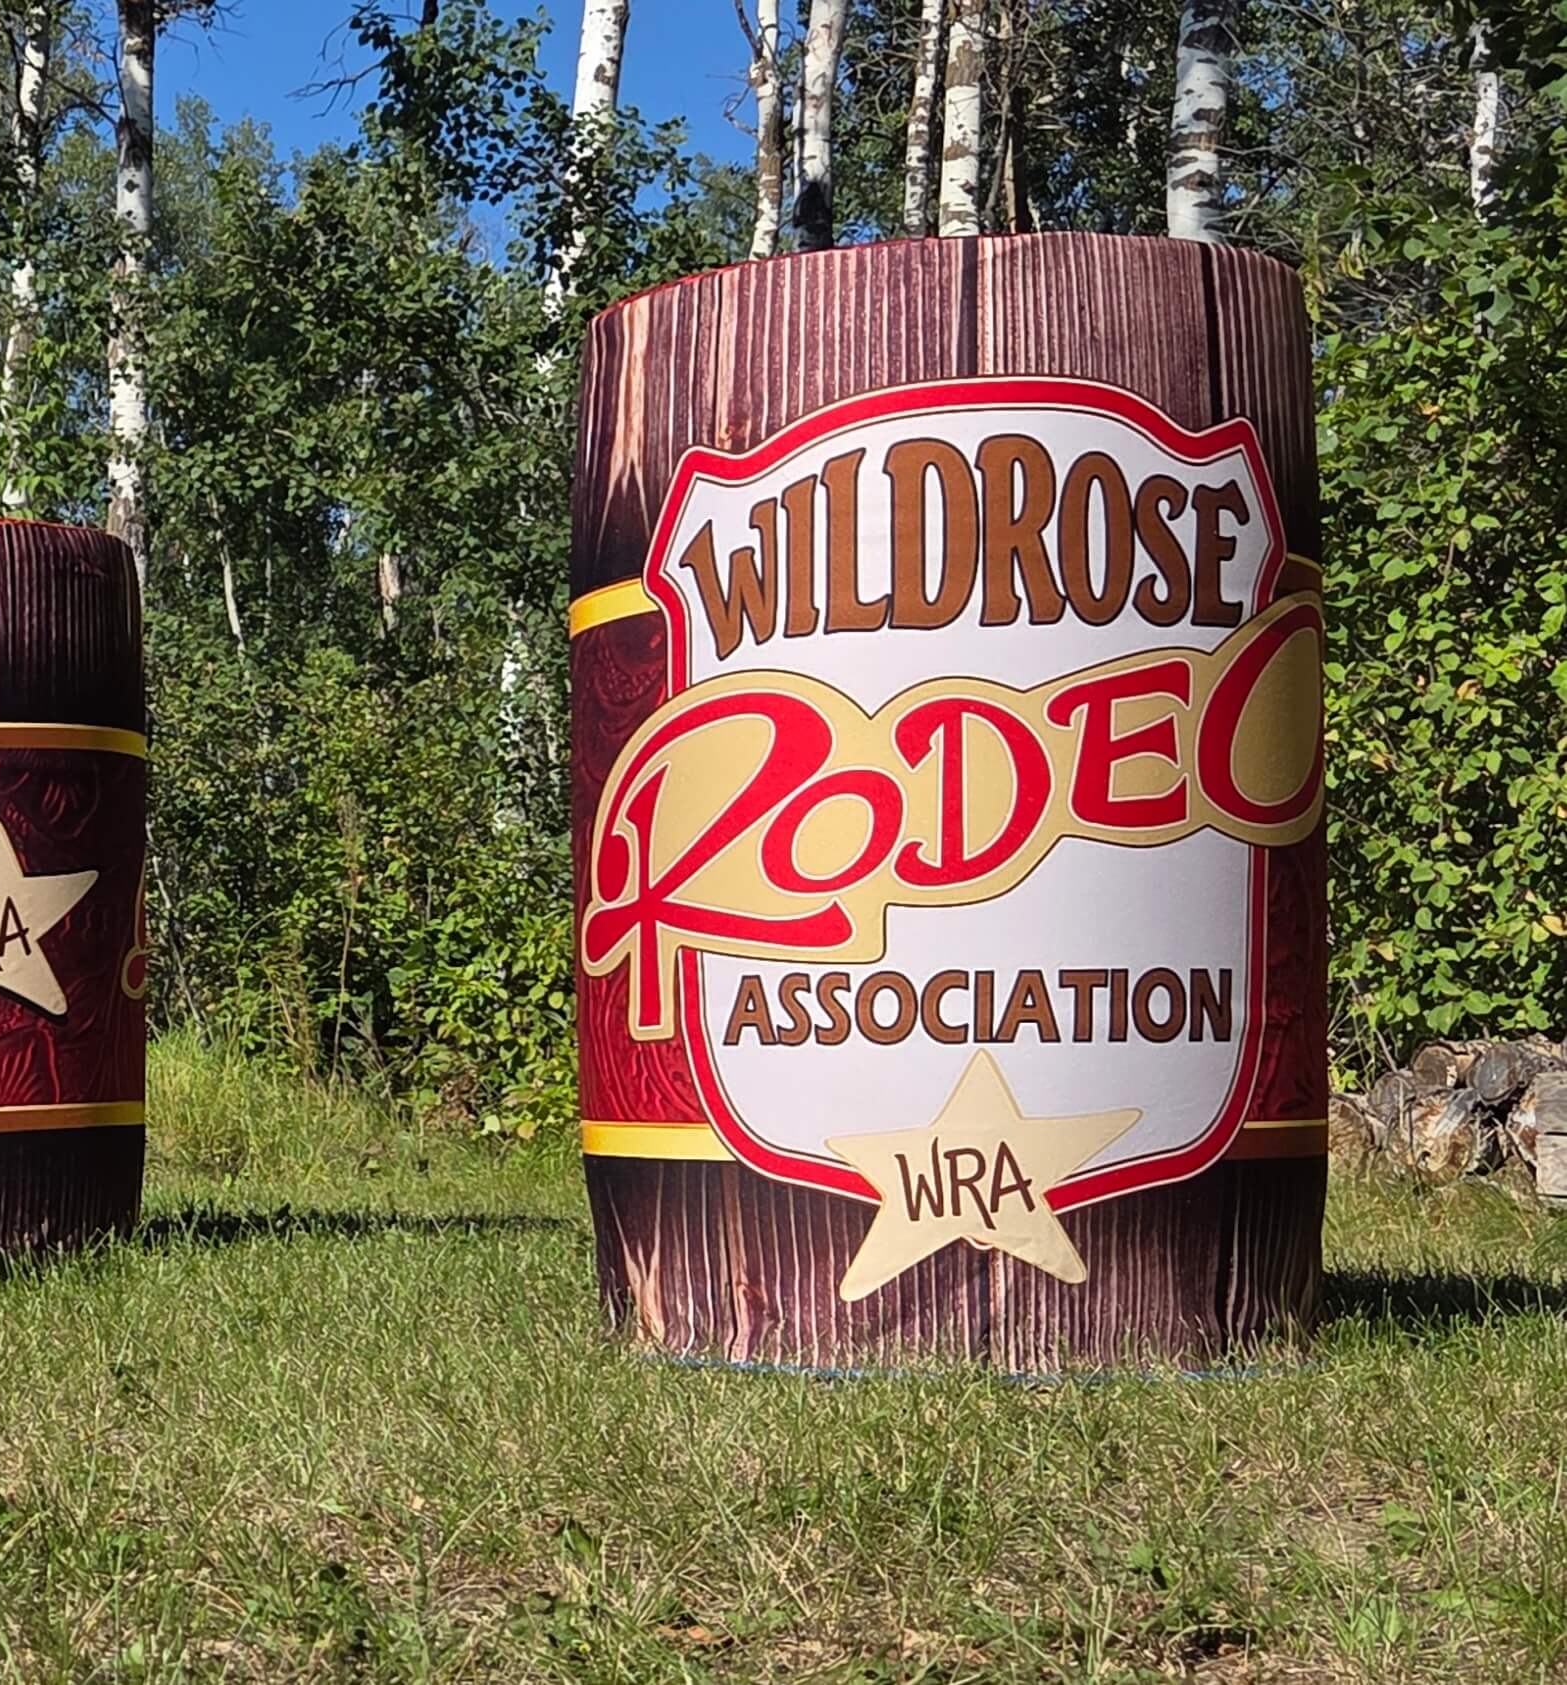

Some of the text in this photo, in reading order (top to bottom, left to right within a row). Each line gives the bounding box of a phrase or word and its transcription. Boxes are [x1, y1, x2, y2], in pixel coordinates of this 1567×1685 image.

[679, 433, 1250, 660] WILDROSE
[723, 967, 1231, 1046] ASSOCIATION
[894, 1136, 1036, 1230] WRA
